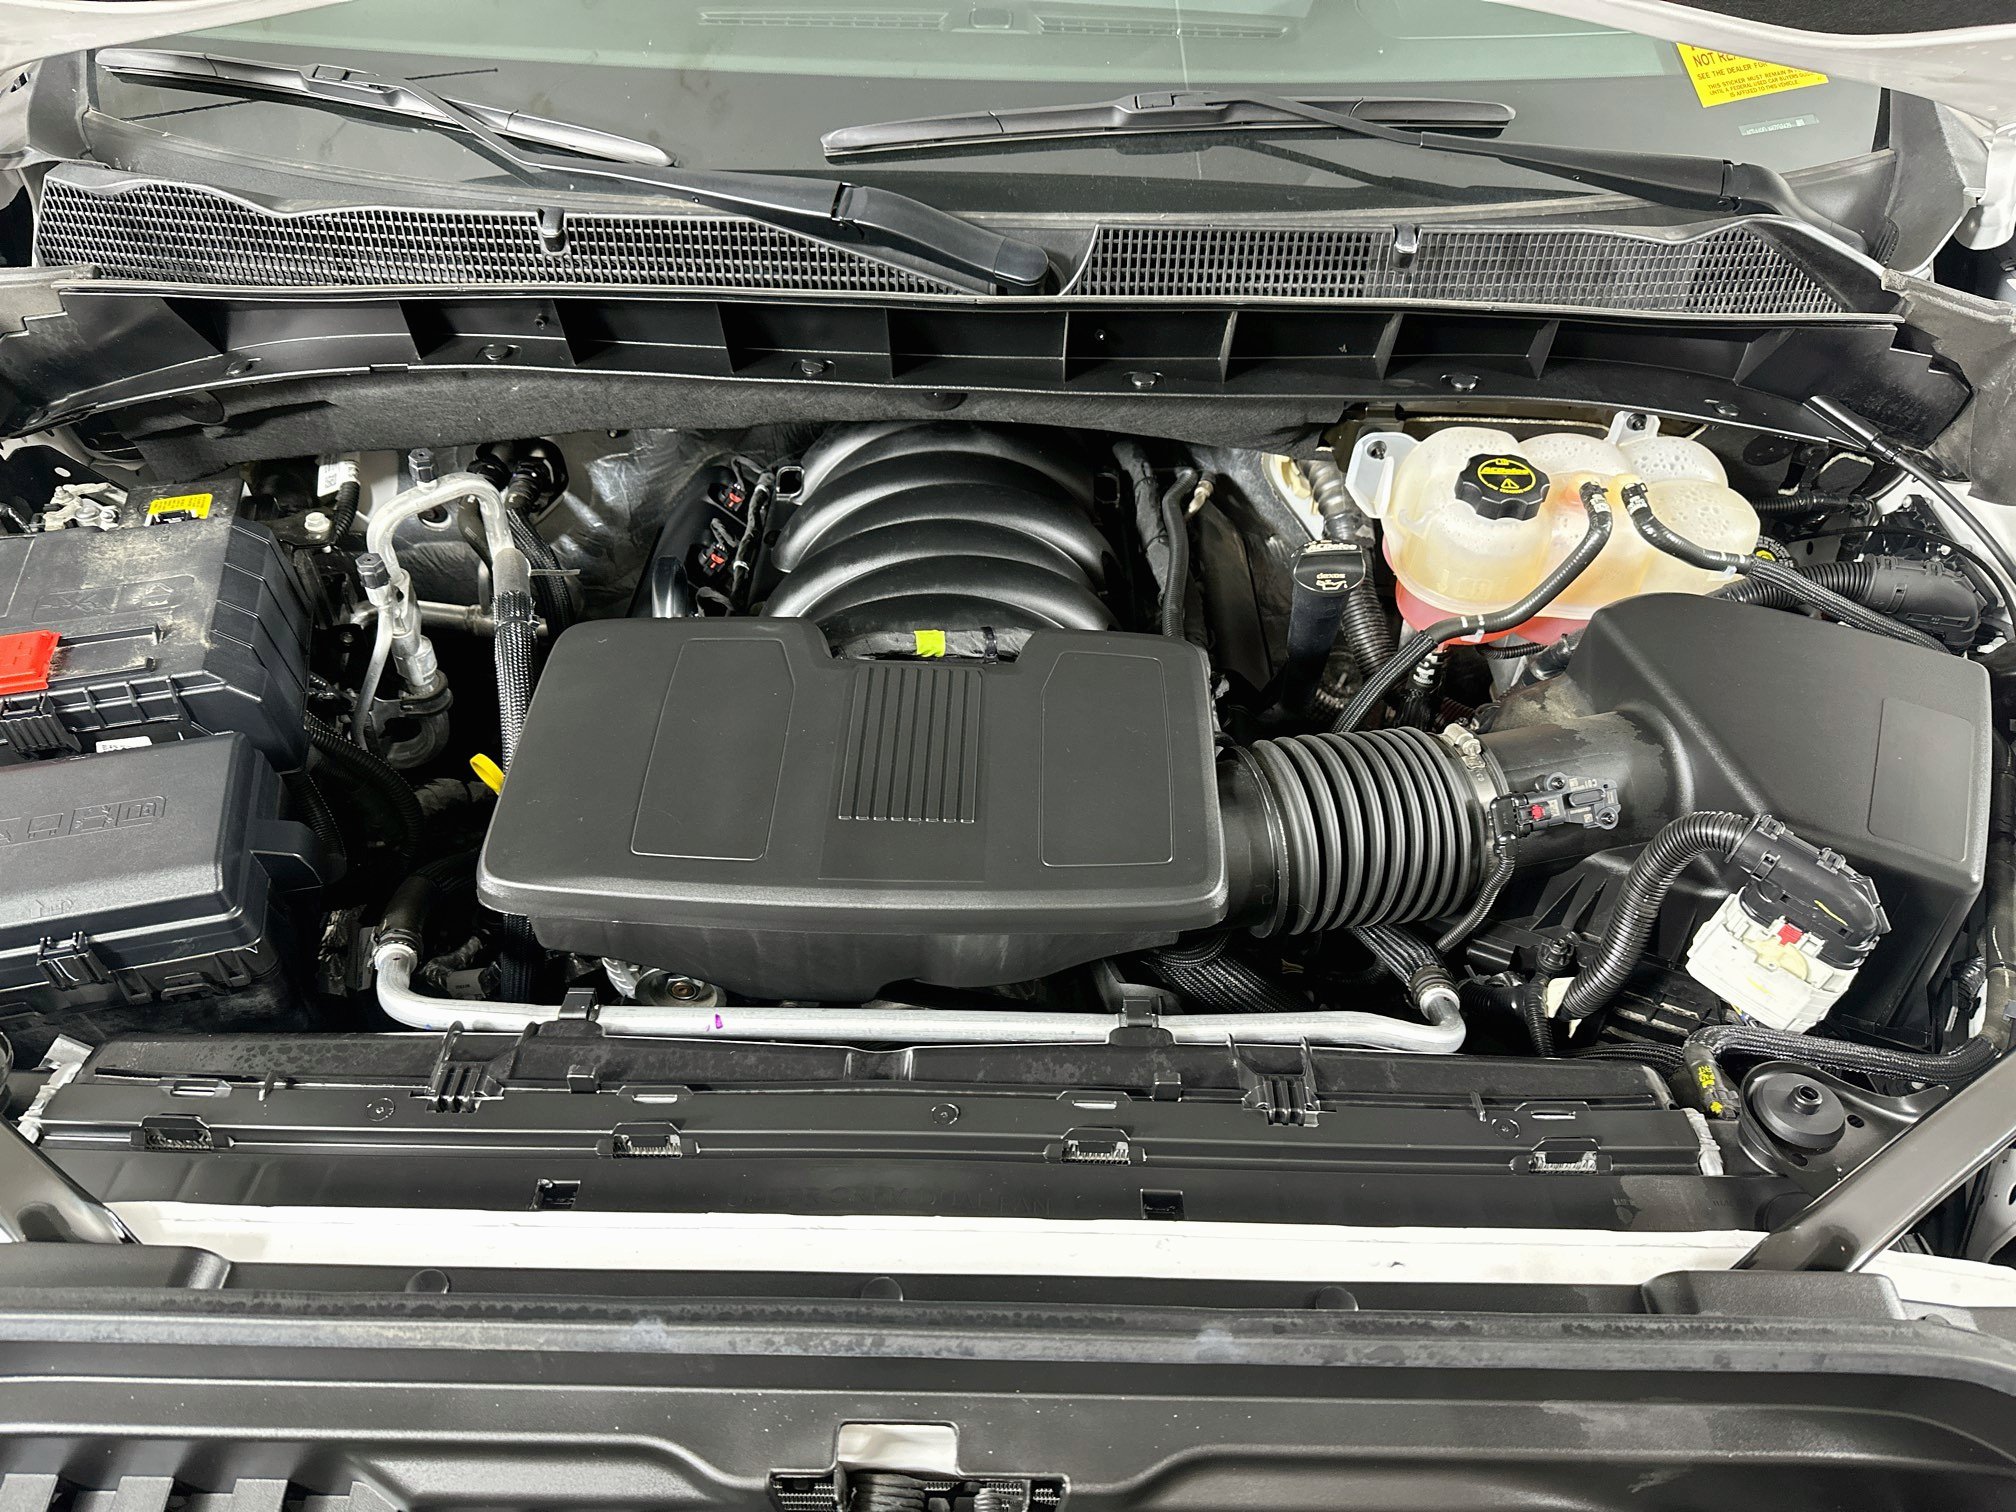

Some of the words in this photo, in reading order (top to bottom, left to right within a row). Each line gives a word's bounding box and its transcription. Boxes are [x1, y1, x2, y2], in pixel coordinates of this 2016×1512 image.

[1692, 52, 1716, 68] NOT
[1697, 71, 1711, 80] SEE
[1712, 68, 1726, 77] THE
[1726, 63, 1752, 74] DEALER
[1708, 82, 1722, 90] THIS
[1722, 77, 1746, 87] STICKER
[1746, 74, 1763, 82] MUST
[1764, 70, 1787, 78] REMAIN
[1730, 82, 1753, 91] FEDERAL
[1753, 79, 1767, 87] USED
[1779, 73, 1799, 81] BUYERS
[1736, 87, 1758, 96] AFFIXED
[1778, 79, 1799, 88] VEHICLE
[1305, 543, 1358, 553] ACDelco
